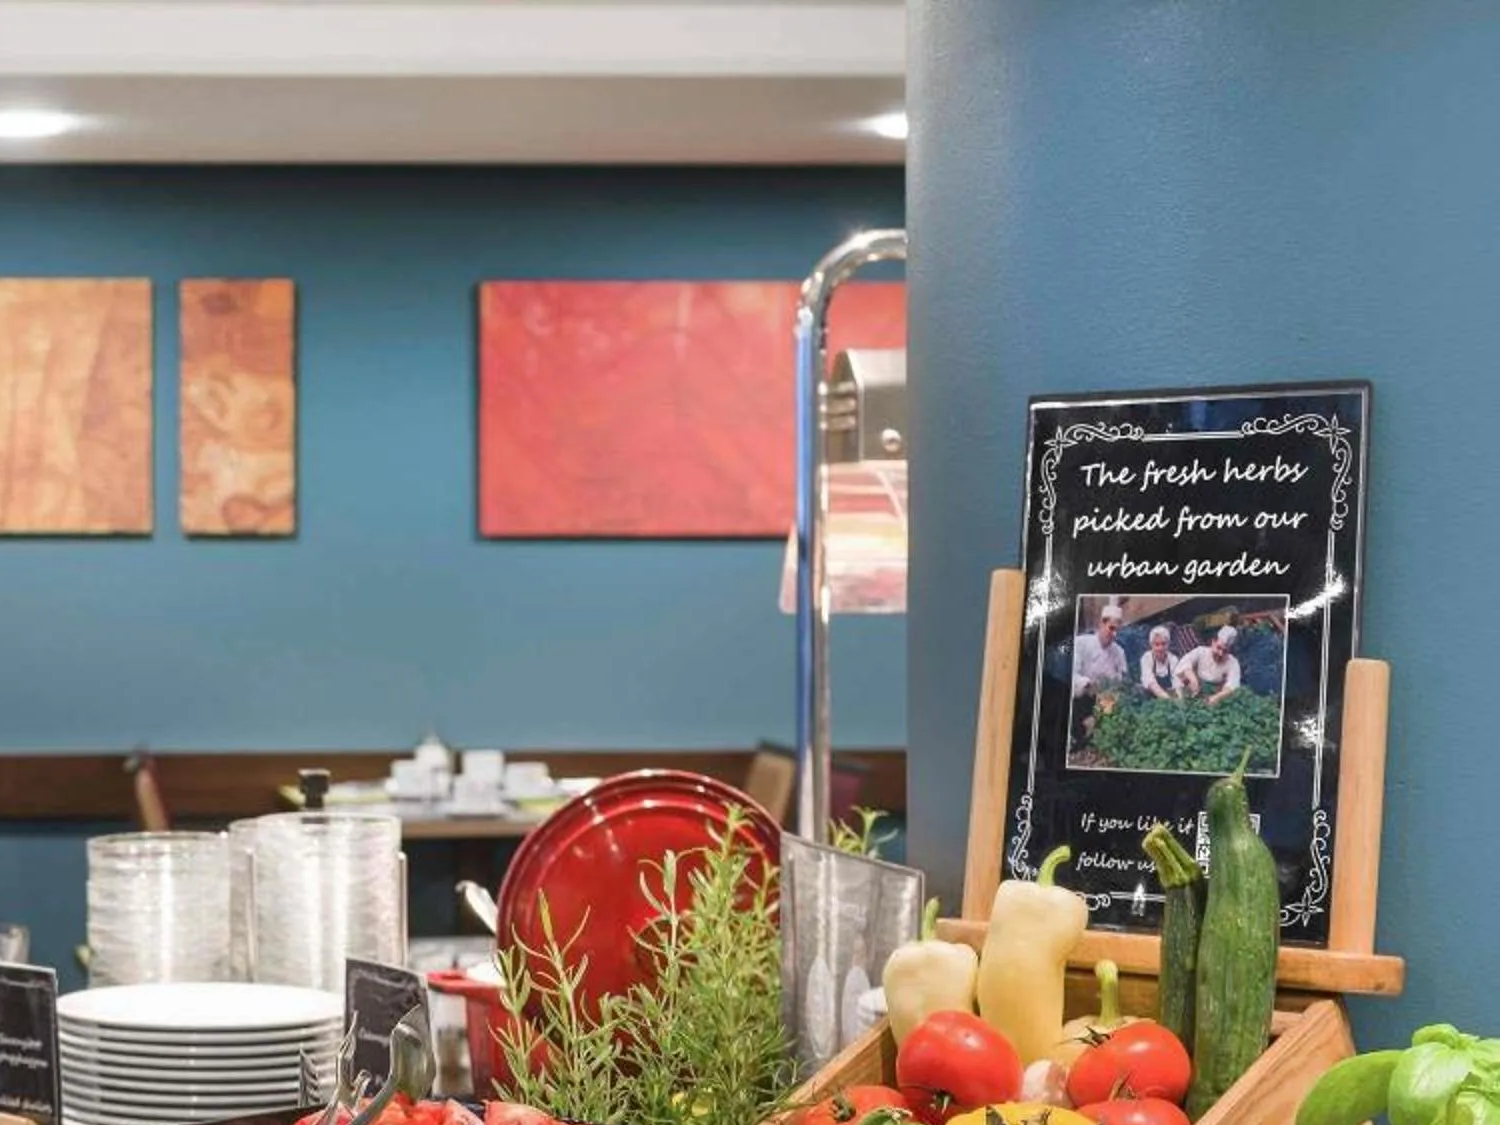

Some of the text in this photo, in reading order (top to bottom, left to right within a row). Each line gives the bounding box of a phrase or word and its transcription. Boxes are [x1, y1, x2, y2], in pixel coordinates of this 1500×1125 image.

[1080, 455, 1309, 493] The fresh herbs
[1072, 505, 1308, 540] picked from our
[1087, 551, 1291, 585] urban garden
[1080, 812, 1097, 833] If
[1099, 817, 1133, 833] you
[1177, 817, 1195, 836] it
[1076, 851, 1156, 872] follow us
